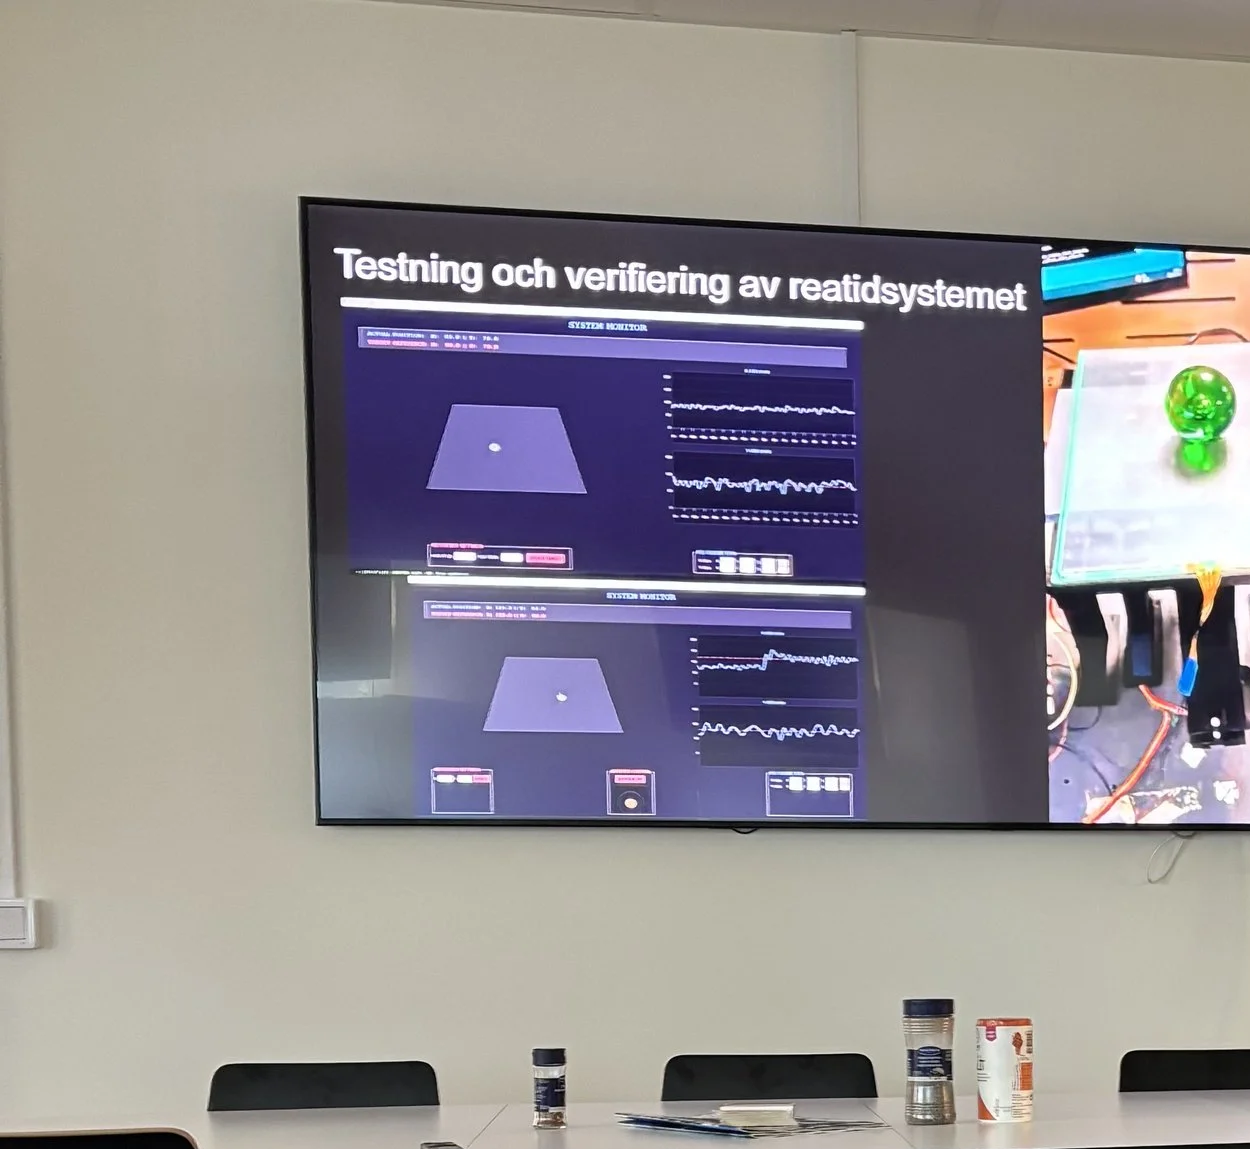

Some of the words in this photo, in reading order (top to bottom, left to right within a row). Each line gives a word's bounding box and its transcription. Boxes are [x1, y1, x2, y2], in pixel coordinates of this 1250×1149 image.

[333, 247, 484, 293] Testning
[491, 257, 557, 289] och
[564, 261, 731, 304] verifiering
[738, 273, 782, 299] av
[789, 273, 1028, 313] reatidsystemet
[567, 320, 605, 330] SYSTEM
[605, 322, 648, 332] MONITOR
[606, 592, 639, 600] SYSTEM
[639, 593, 677, 601] MONITOR
